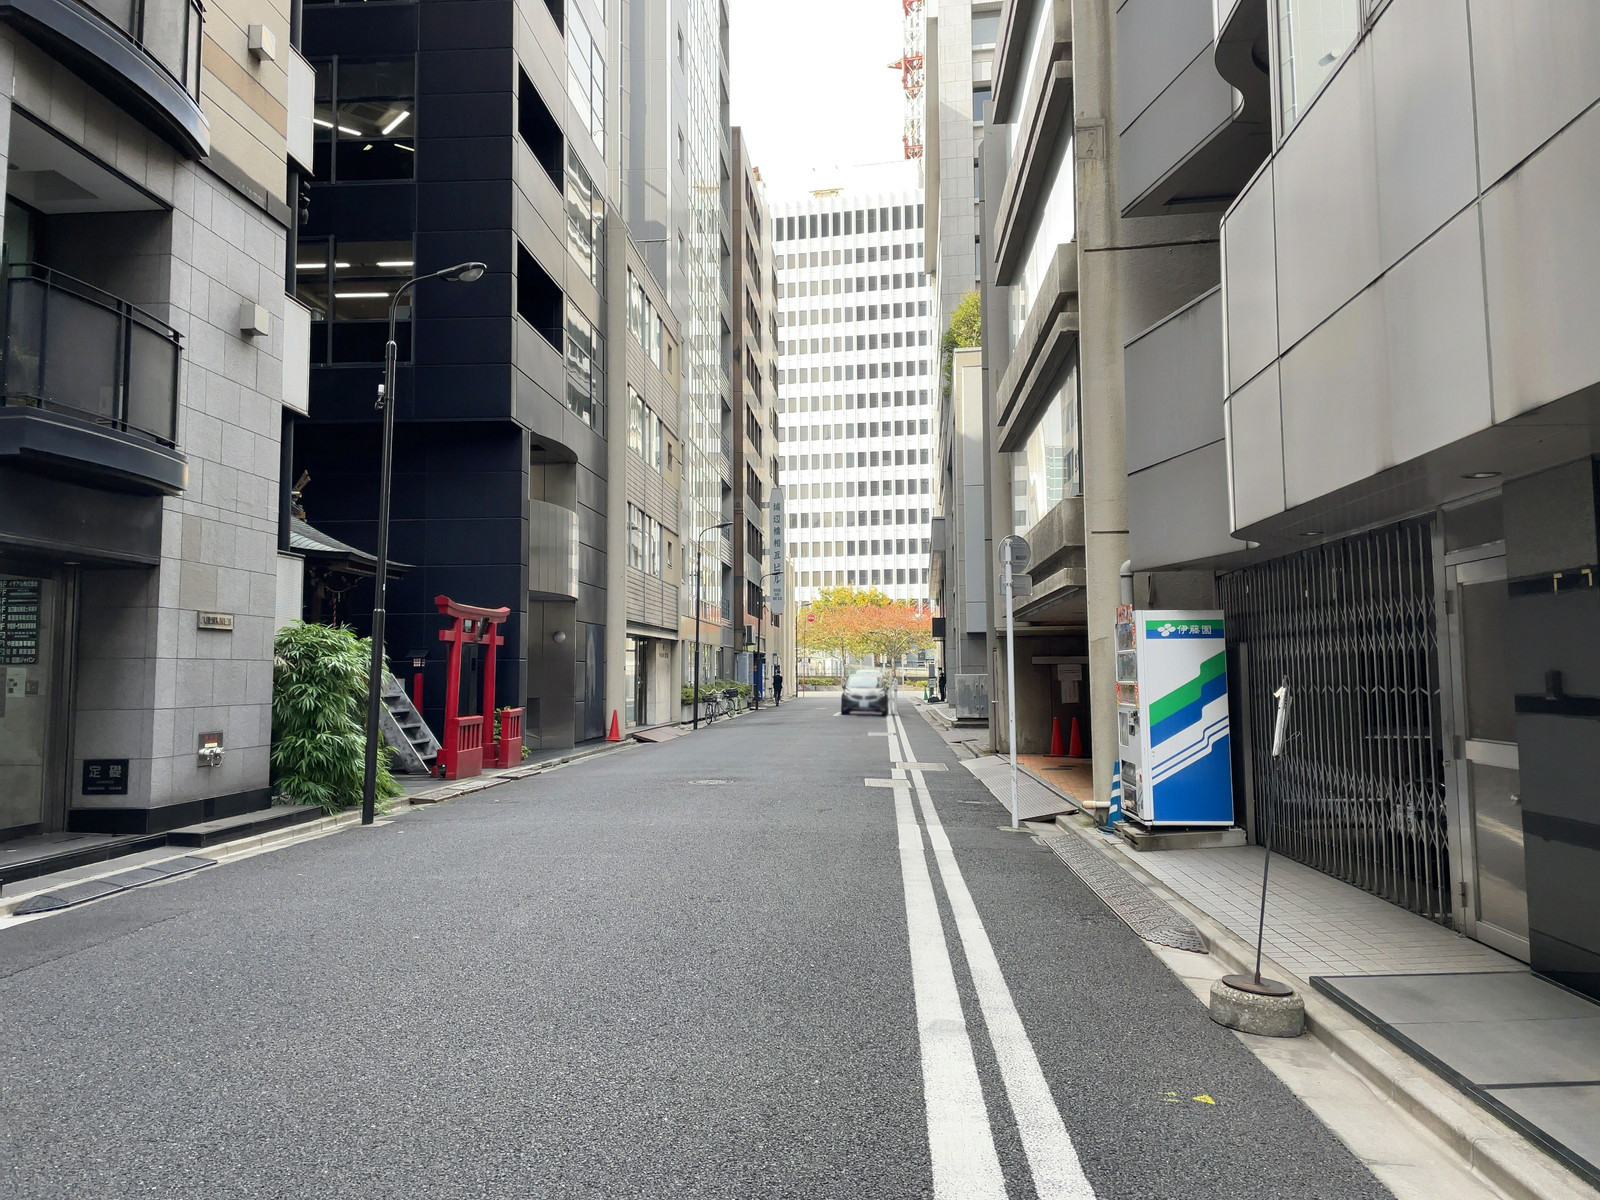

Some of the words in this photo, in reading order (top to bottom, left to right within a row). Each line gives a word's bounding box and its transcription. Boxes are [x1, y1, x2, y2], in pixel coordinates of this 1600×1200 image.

[1177, 624, 1212, 635] 伊藤園
[89, 765, 122, 778] 定礎
